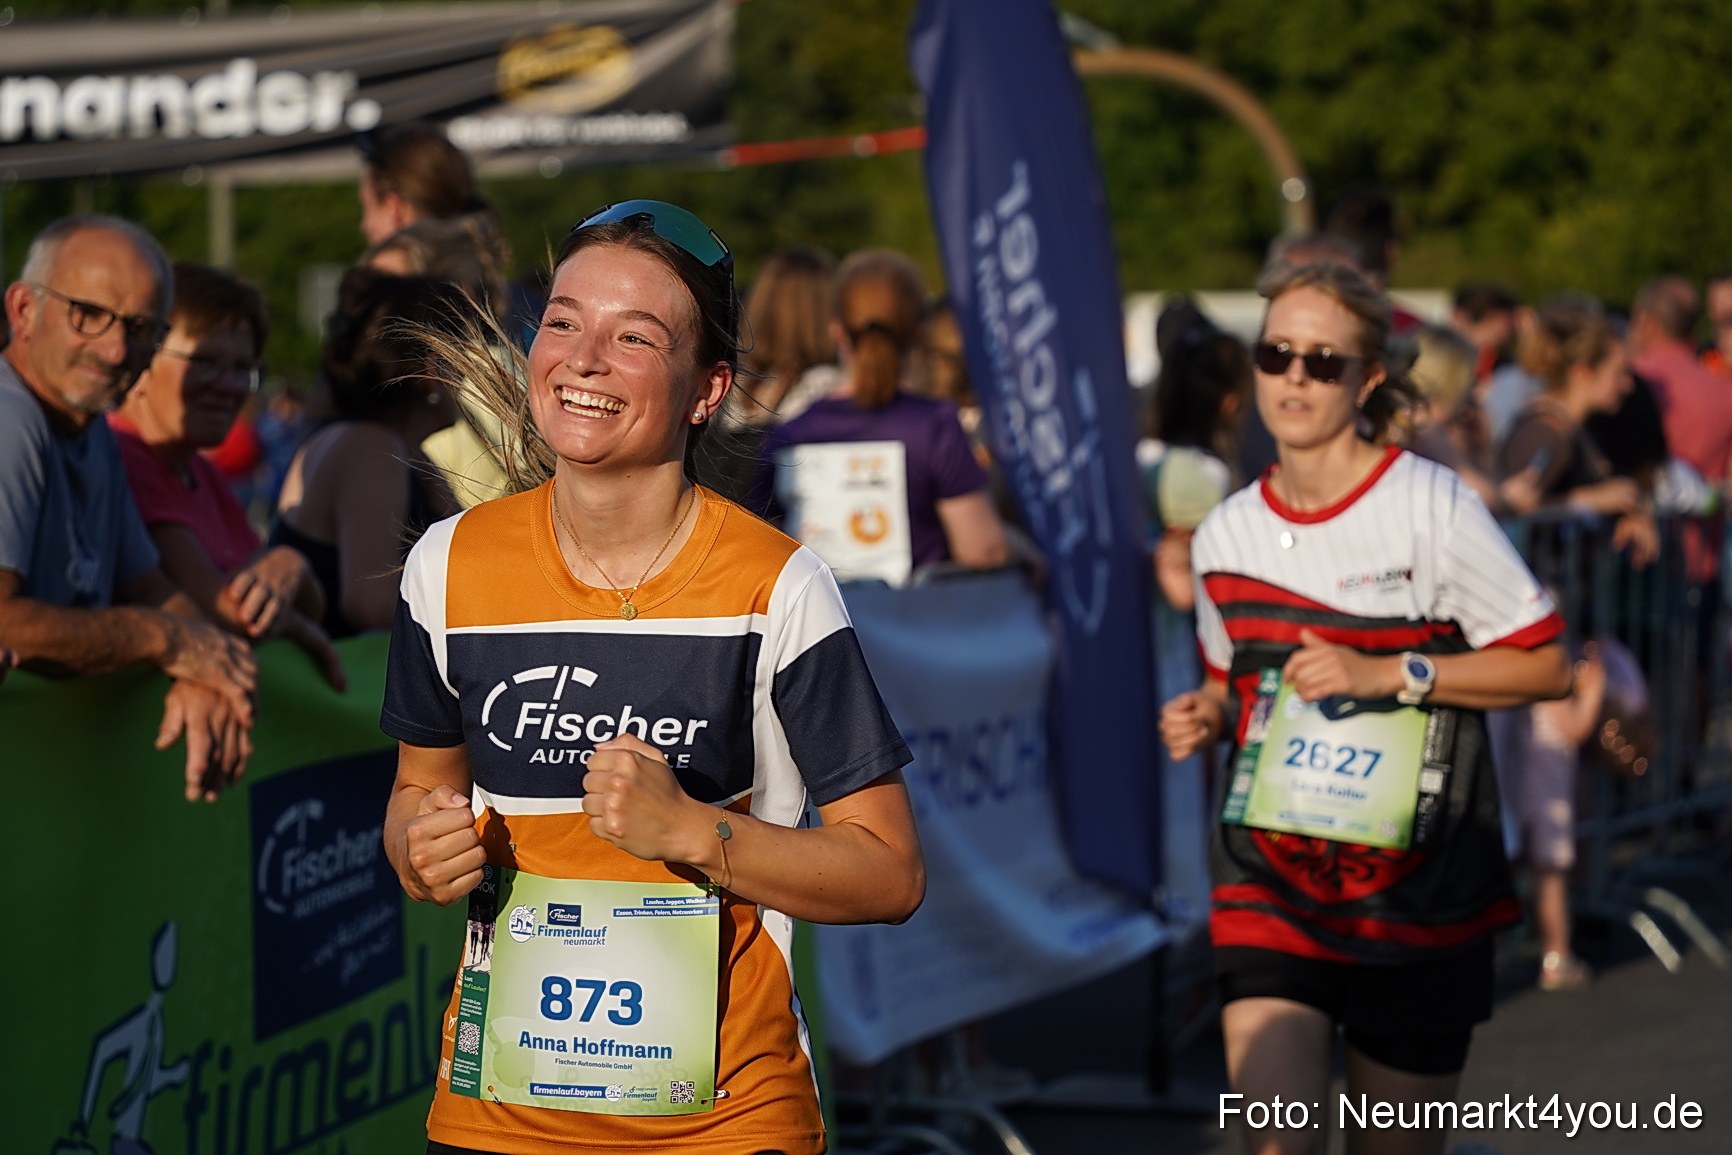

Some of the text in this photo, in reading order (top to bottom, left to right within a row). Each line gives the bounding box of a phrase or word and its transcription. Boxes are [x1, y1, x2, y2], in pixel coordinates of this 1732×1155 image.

[514, 701, 709, 747] Fischer
[529, 748, 692, 769] AUTOLE
[1285, 737, 1382, 778] 2627
[282, 825, 383, 897] Fischer
[538, 925, 607, 937] Firmenlauf
[563, 938, 605, 946] neumarkt
[540, 975, 643, 1026] 873
[184, 944, 456, 1155] firmenl
[519, 1031, 673, 1060] Anna Hoffmann
[555, 1058, 577, 1066] Fischer
[578, 1060, 613, 1069] Automobile
[533, 1086, 602, 1098] firmenlauf.bayern
